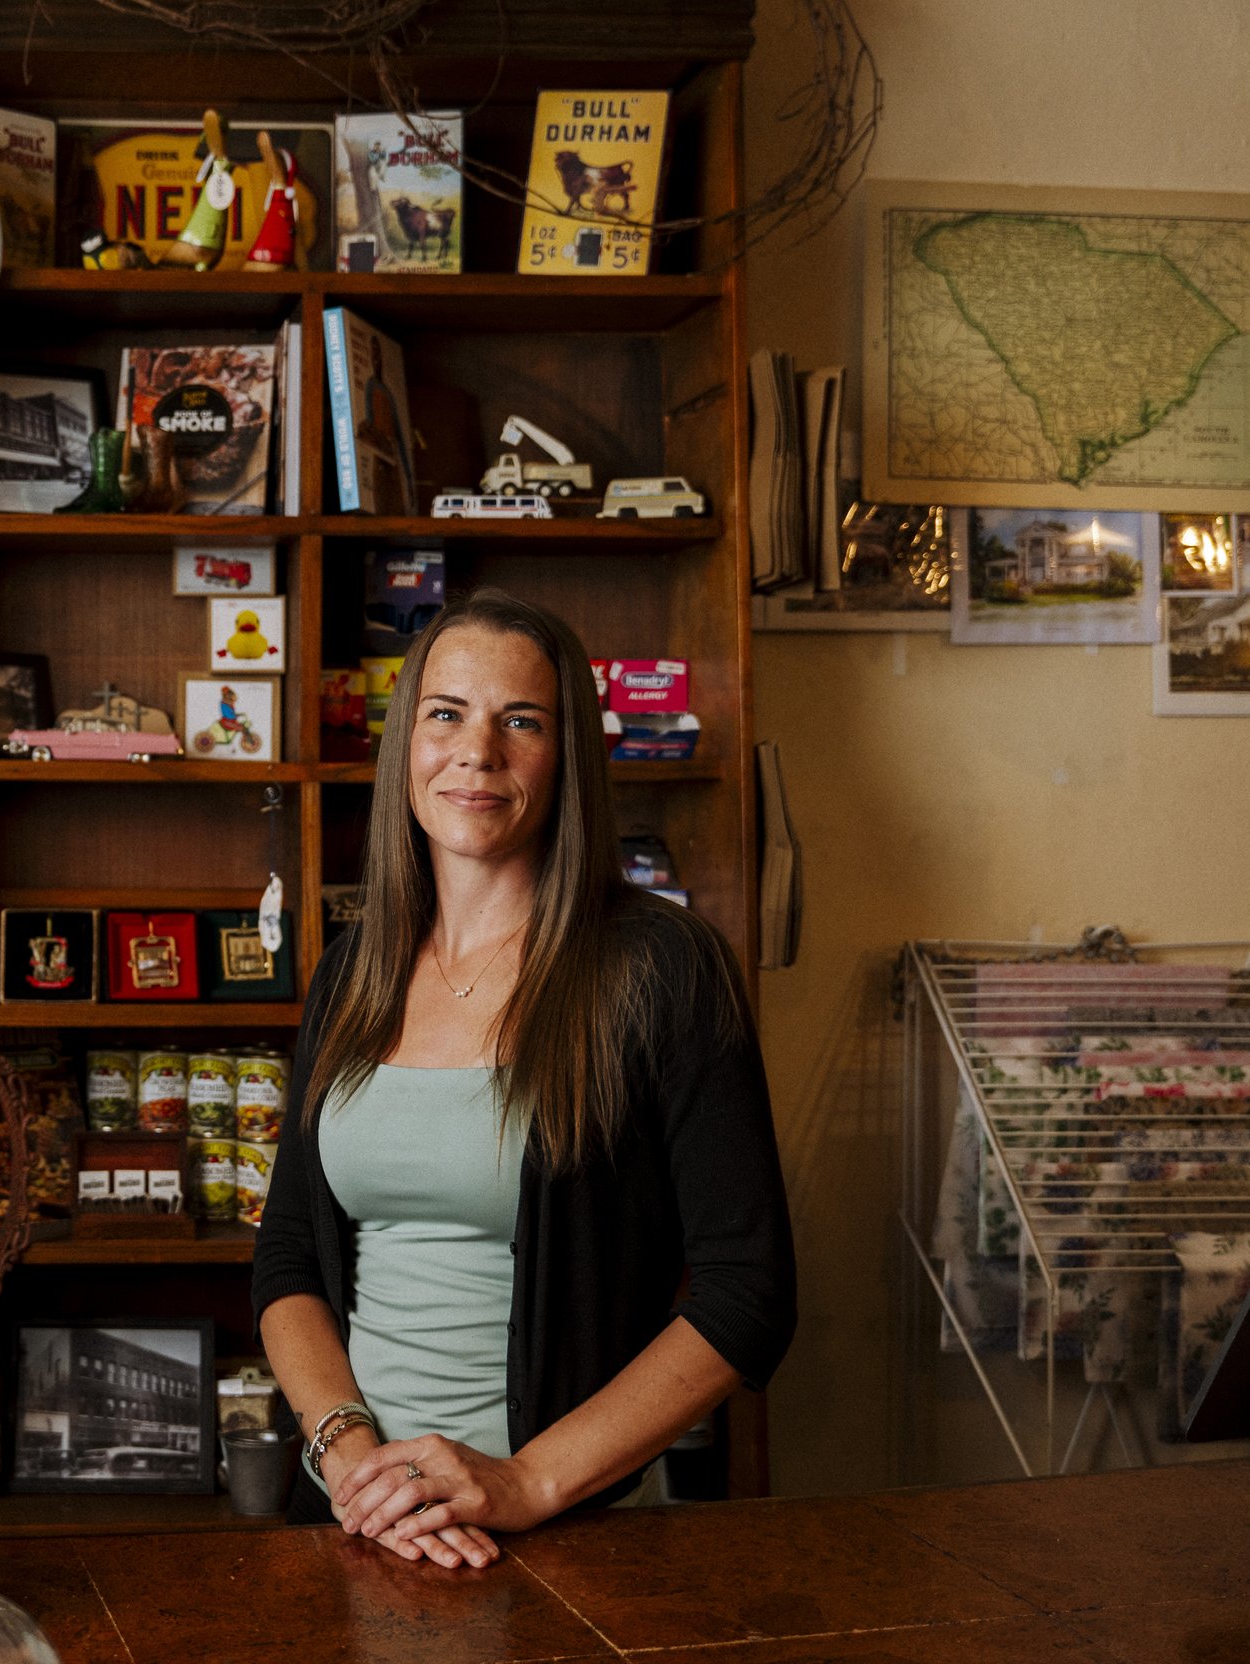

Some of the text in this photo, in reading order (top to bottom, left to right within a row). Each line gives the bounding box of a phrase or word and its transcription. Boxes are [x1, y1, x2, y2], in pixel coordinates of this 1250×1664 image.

[546, 125, 651, 142] DURHAM
[116, 183, 243, 241] NEI
[158, 416, 227, 433] SMOKE
[626, 674, 670, 689] Benadryl
[628, 691, 669, 701] ALLERGY
